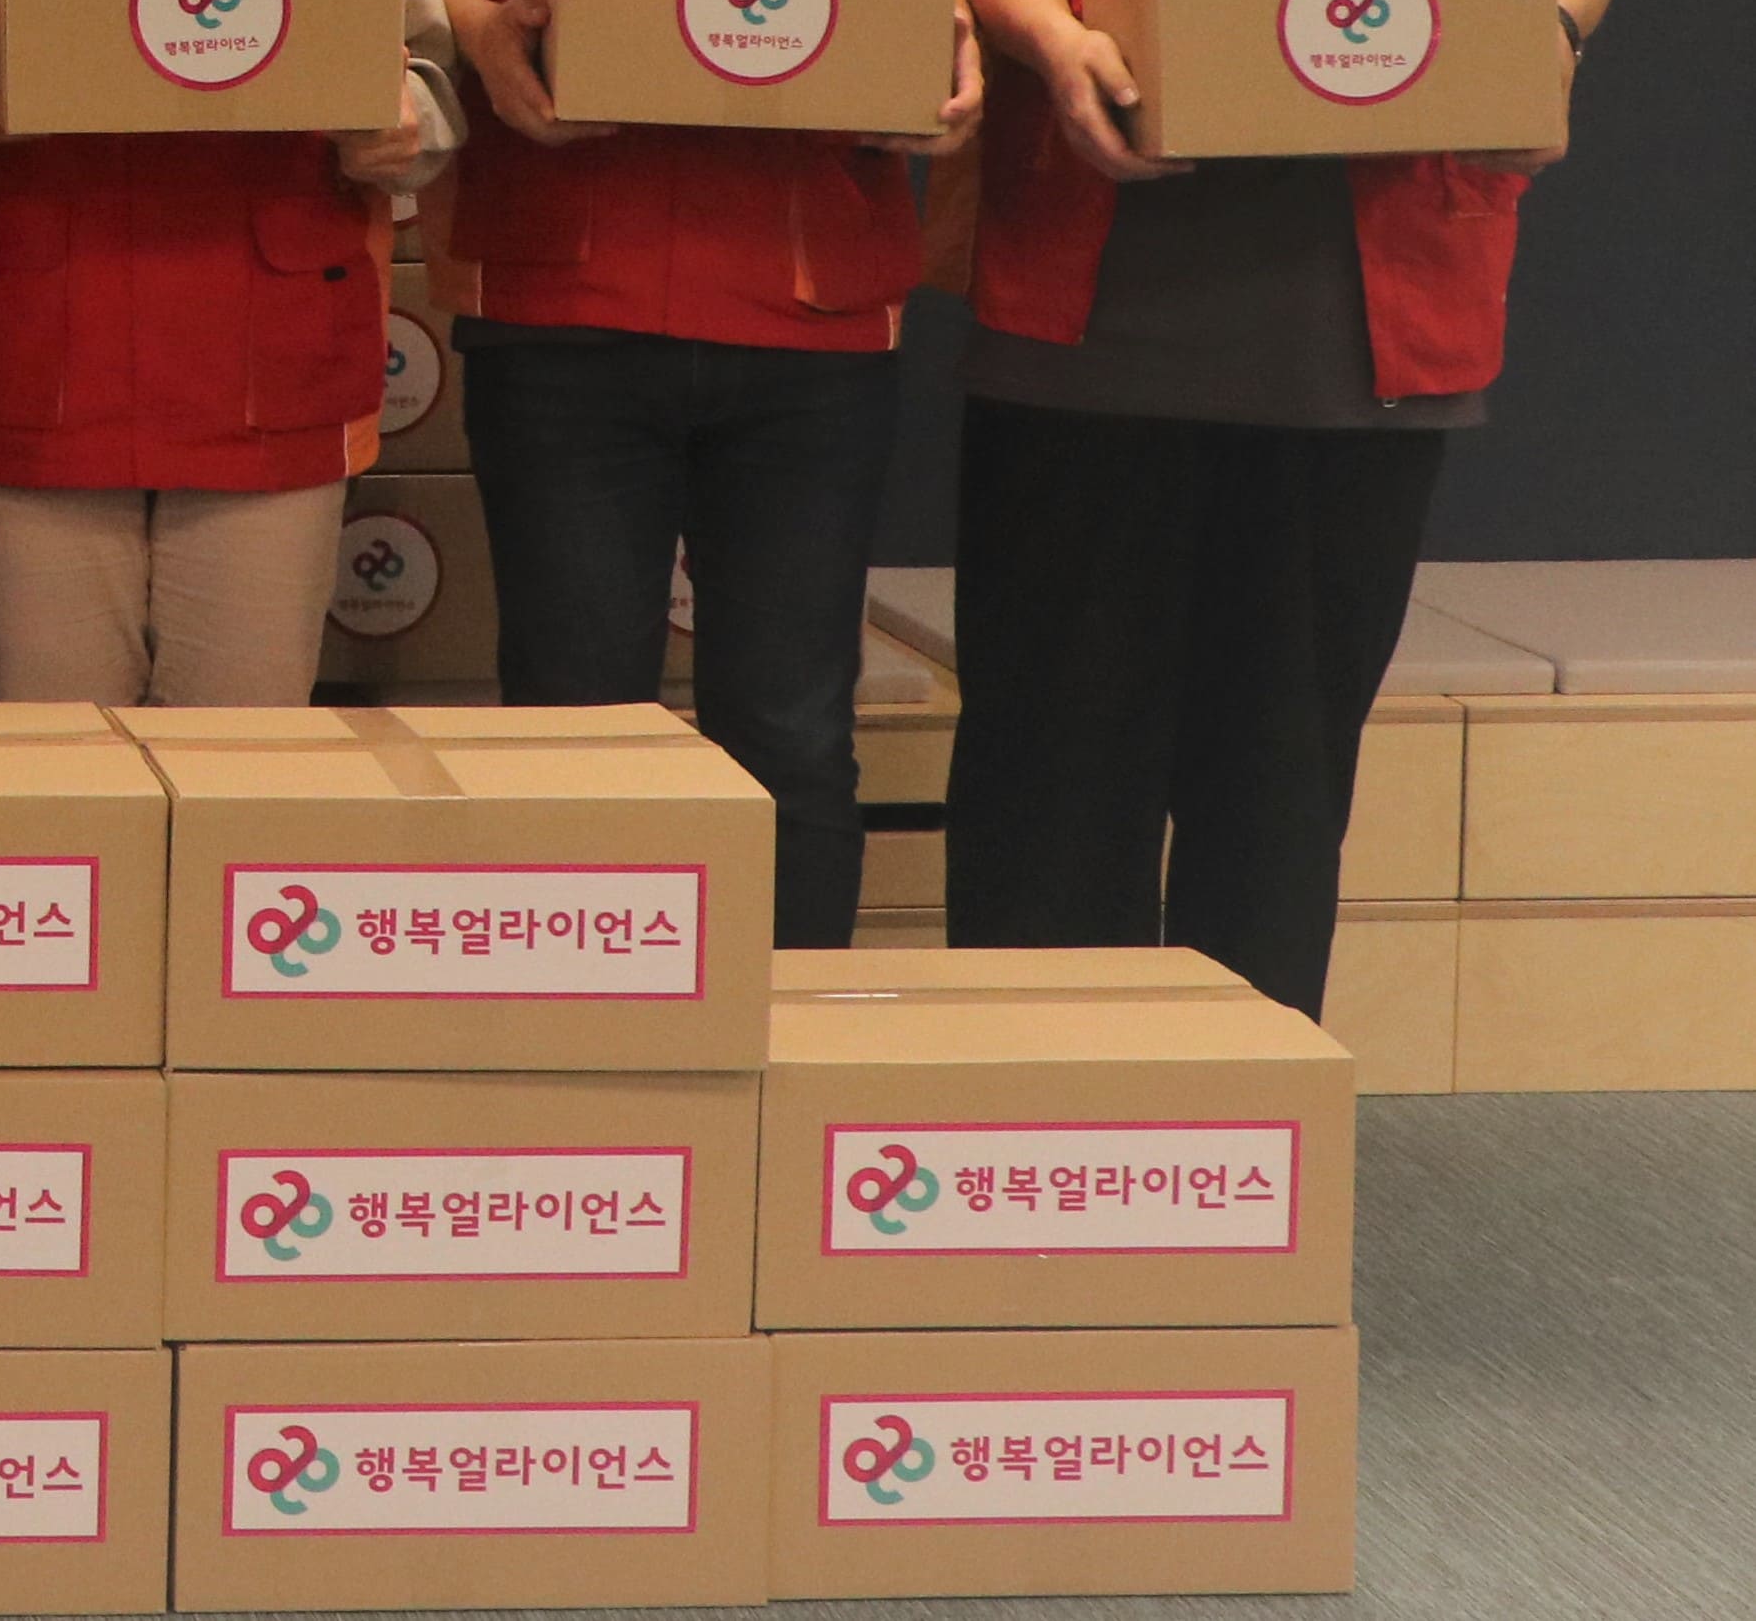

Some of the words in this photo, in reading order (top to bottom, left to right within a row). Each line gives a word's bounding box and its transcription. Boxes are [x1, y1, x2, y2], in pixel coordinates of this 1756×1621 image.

[164, 35, 260, 56] 행복얼라이언스
[709, 33, 801, 49] 행복얼라이언스
[1310, 54, 1405, 68] 행복얼라이언스
[356, 909, 682, 957] 행복얼라이언스
[956, 1165, 1275, 1214] 행복얼라이언스
[348, 1191, 667, 1240] 행복얼라이언스
[356, 1446, 674, 1494] 행복얼라이언스
[952, 1434, 1270, 1484] 행복얼라이언스
